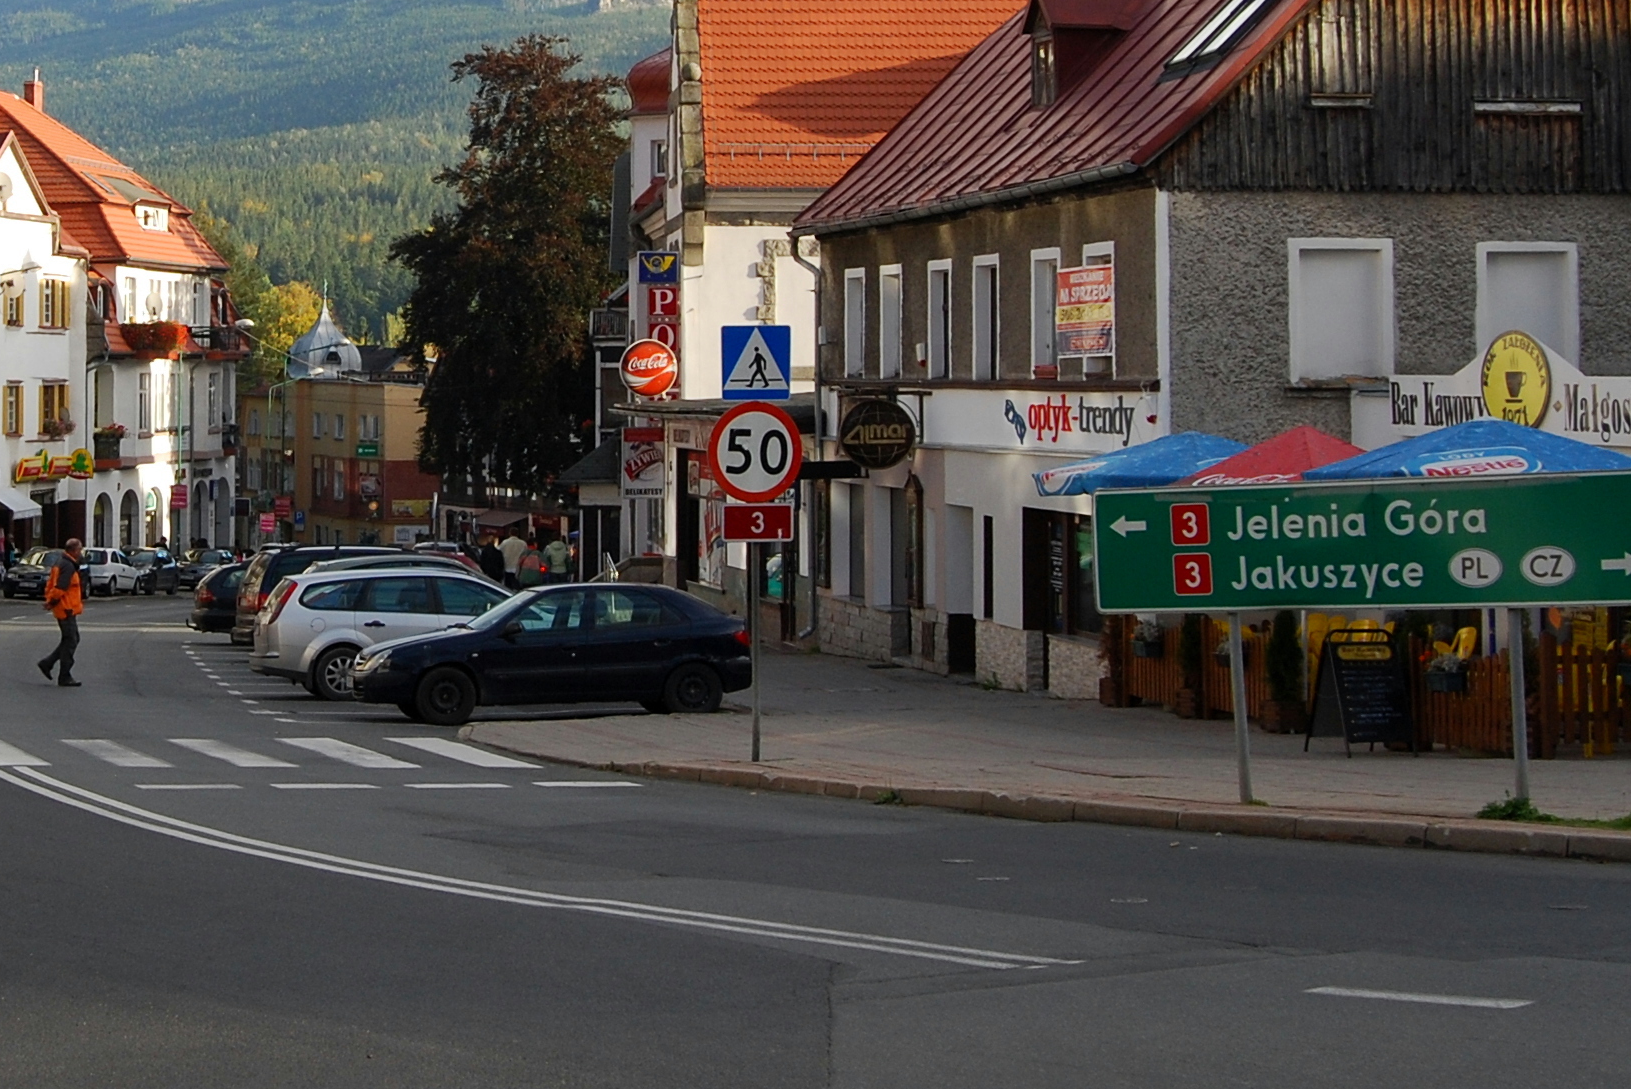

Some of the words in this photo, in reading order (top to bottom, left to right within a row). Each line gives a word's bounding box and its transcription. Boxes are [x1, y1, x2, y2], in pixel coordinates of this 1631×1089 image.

[1028, 394, 1136, 446] optyk-trendy
[1391, 382, 1418, 426] Bar
[726, 428, 788, 475] 50
[625, 488, 663, 496] DELIKATESY
[750, 512, 765, 534] 3
[1181, 512, 1198, 538] 3
[1227, 503, 1366, 541] Jelenia
[1384, 499, 1487, 537] Góra
[1185, 561, 1201, 588] 3
[1231, 555, 1424, 598] Jakuszyce
[1461, 557, 1489, 580] PL
[1529, 554, 1563, 579] CZ
